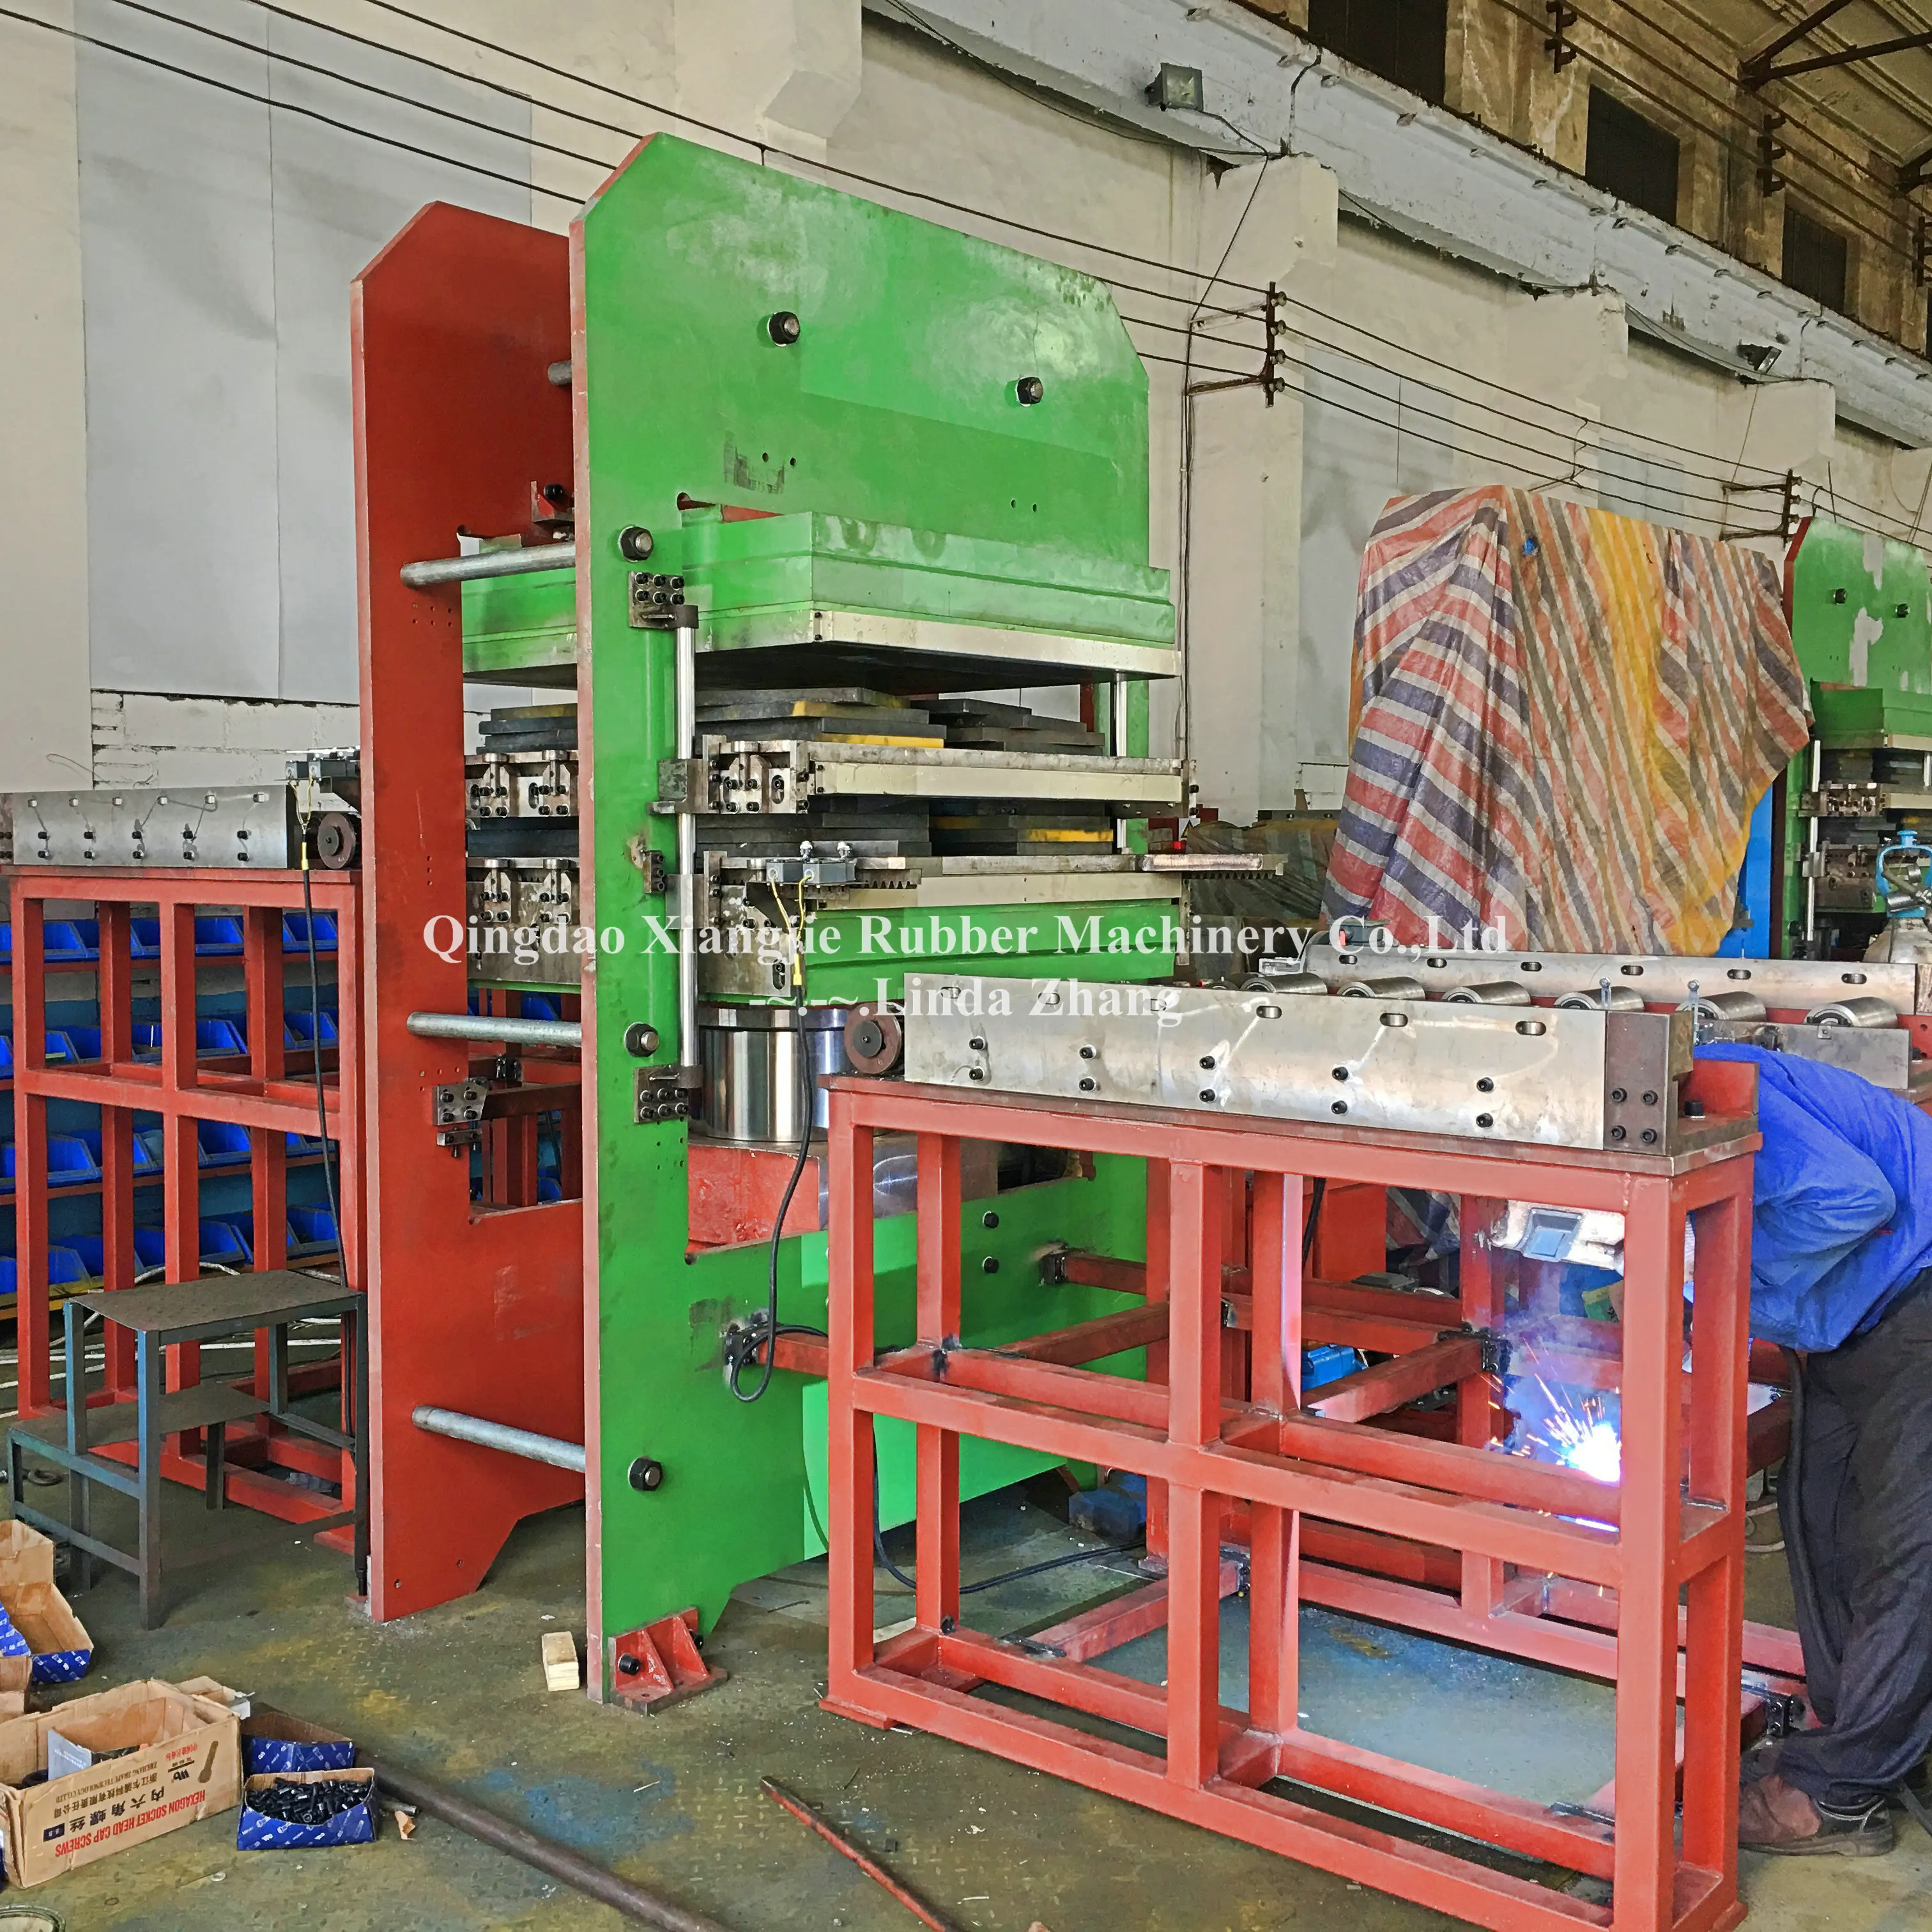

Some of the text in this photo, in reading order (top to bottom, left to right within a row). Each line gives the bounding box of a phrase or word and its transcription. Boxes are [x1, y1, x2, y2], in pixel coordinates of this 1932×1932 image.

[69, 1786, 165, 1833] 内六角螺丝
[77, 1777, 114, 1796] TECHNOLOGY
[55, 1789, 206, 1857] HEXAGON SOCKET HEAD CAP SCREWS
